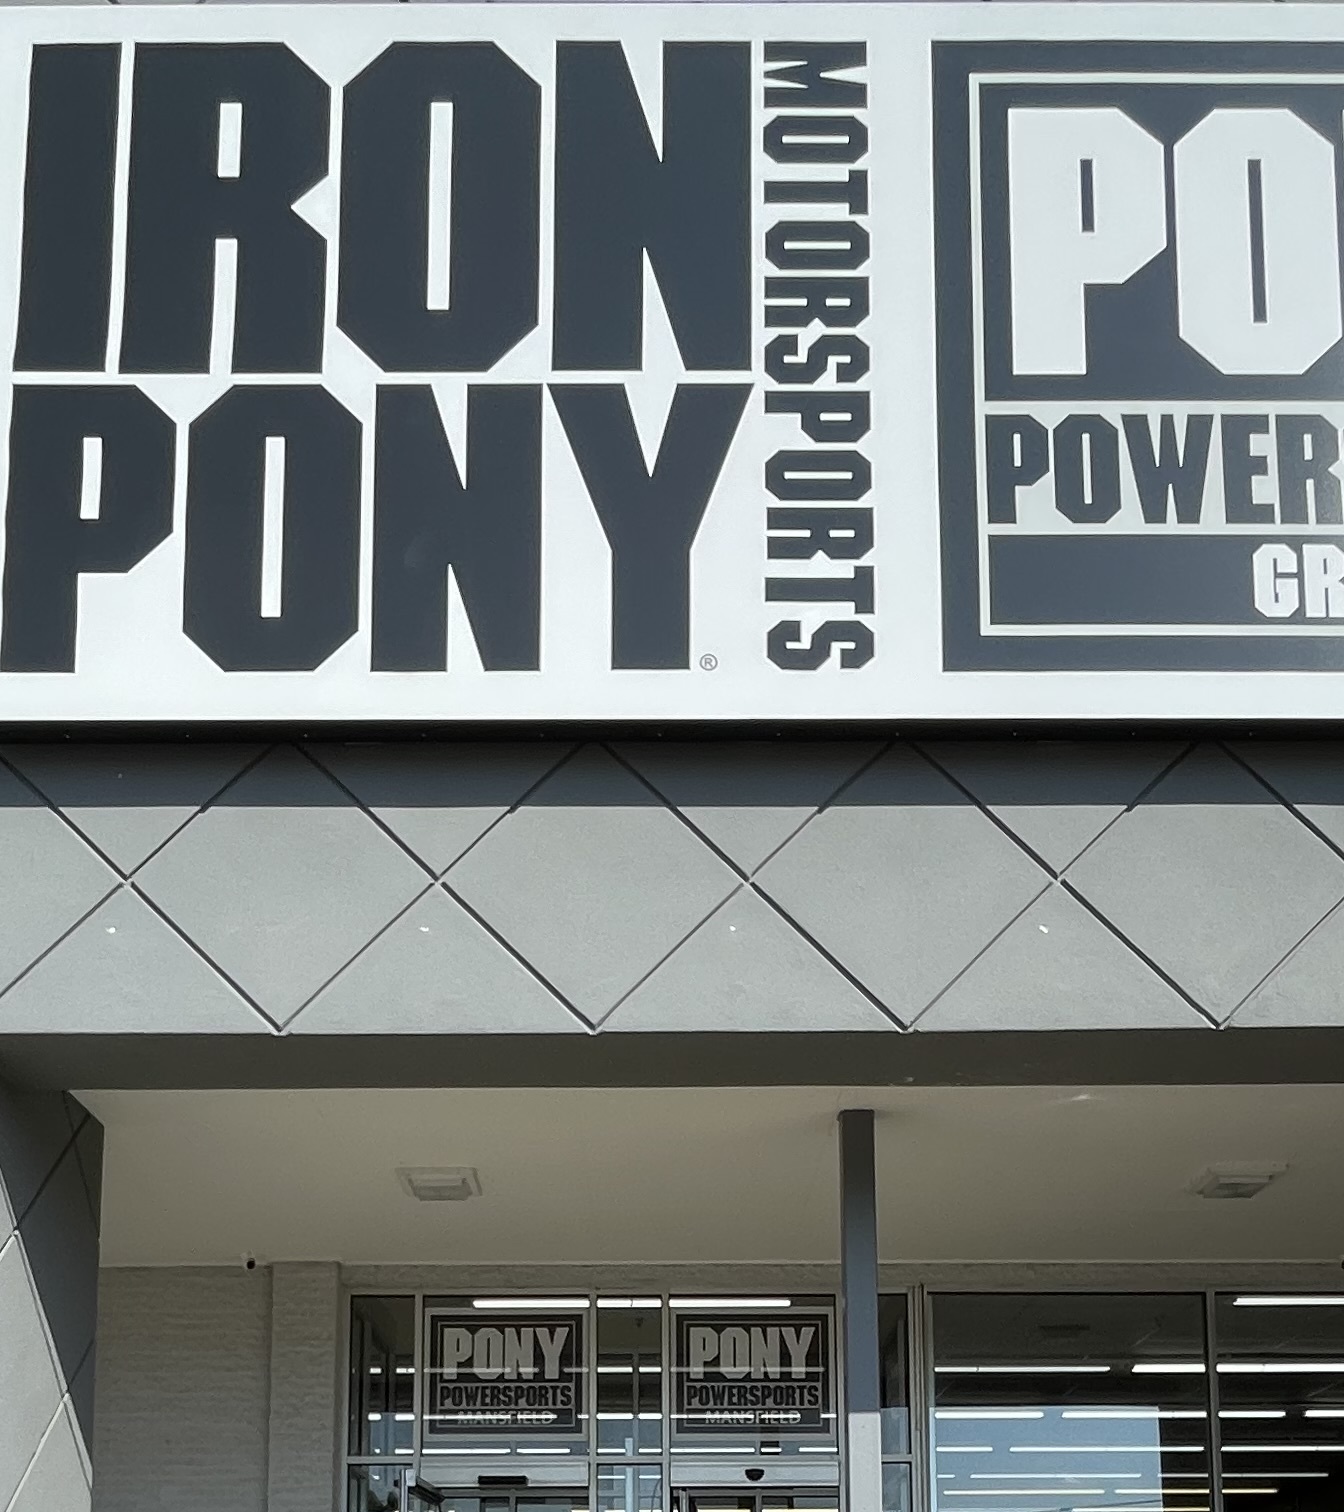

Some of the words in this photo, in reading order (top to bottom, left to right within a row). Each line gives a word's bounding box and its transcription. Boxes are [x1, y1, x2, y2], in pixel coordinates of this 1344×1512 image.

[13, 41, 752, 374] IRON
[762, 40, 876, 671] MOTORSPORTS
[0, 383, 754, 672] PONY
[443, 1327, 569, 1379] PONY
[689, 1326, 816, 1379] PONY
[440, 1385, 572, 1407] POWERSPORTS
[686, 1385, 819, 1406] POWERSPORTS
[705, 1410, 801, 1424] MANSFIELD
